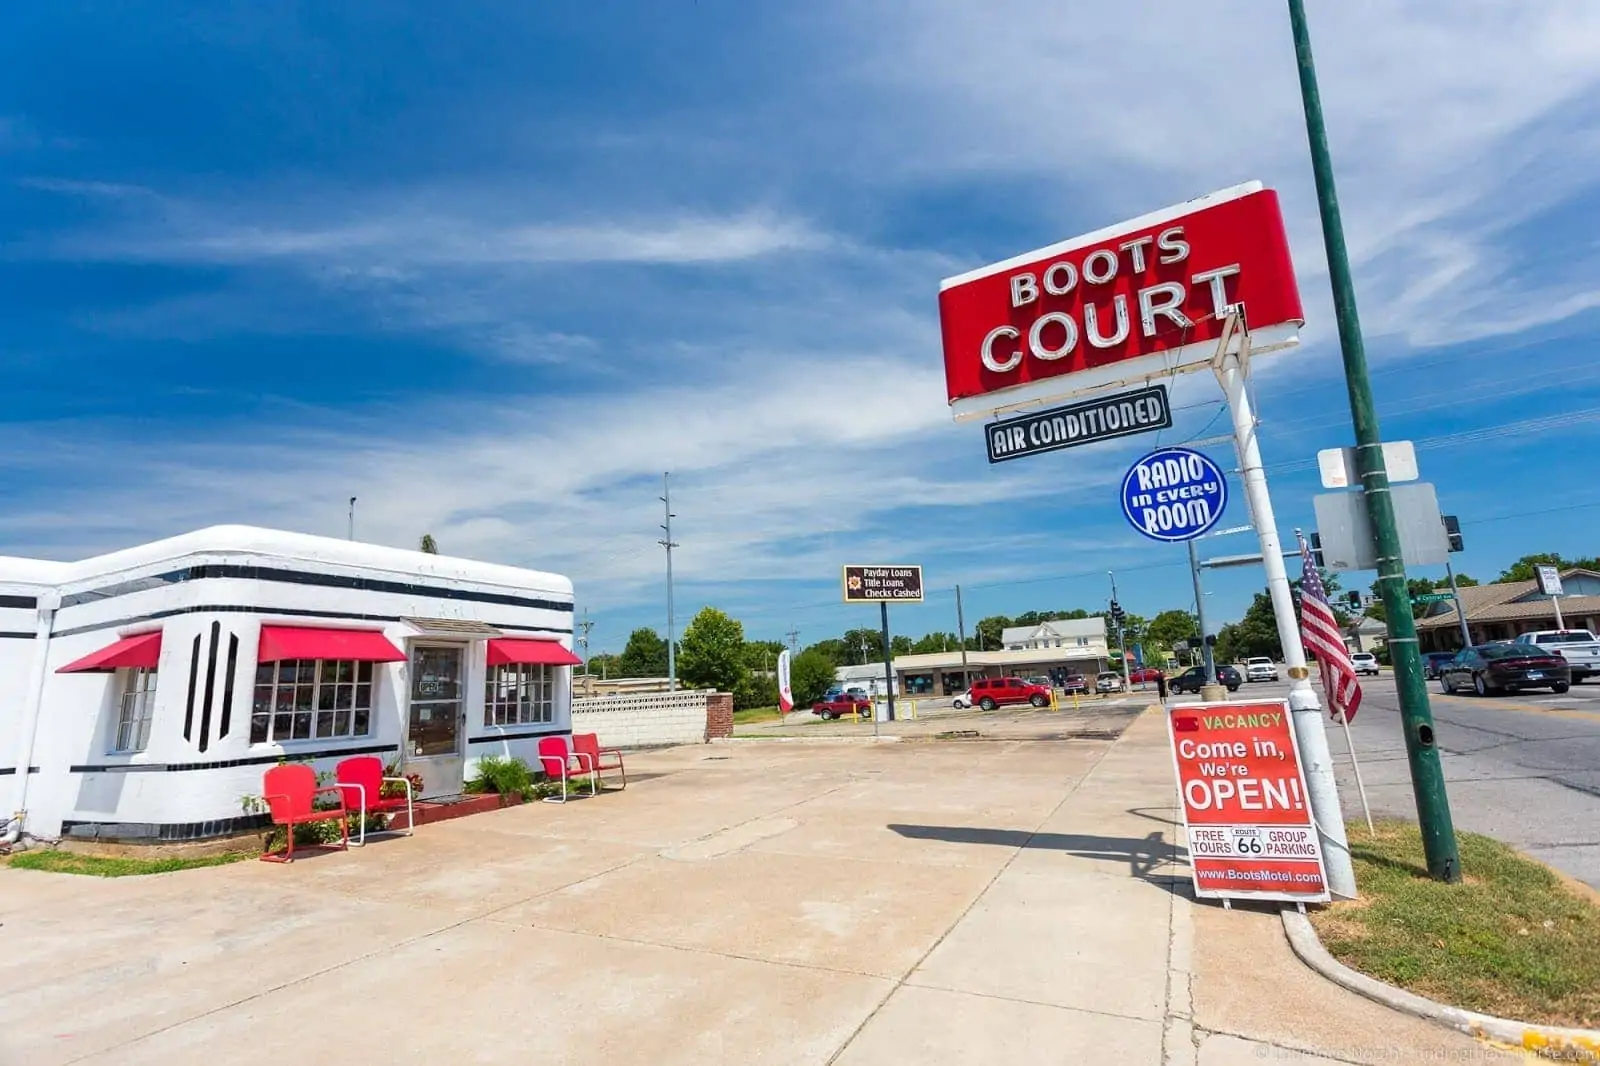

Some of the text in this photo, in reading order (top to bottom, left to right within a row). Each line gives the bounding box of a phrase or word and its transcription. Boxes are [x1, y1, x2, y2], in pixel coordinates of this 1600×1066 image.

[1010, 226, 1191, 308] BOOTS
[981, 263, 1240, 373] COURT
[993, 396, 1162, 454] AIR CONDITIONED
[1137, 454, 1204, 491] RADIO
[1156, 482, 1217, 503] EVERY
[1142, 499, 1212, 533] ROOM
[864, 568, 912, 578] Payday Loans
[864, 579, 904, 587] Title Loans
[865, 589, 920, 598] Checks Cashed
[1203, 713, 1281, 730] VACANCY
[1179, 736, 1285, 760] Come in,
[1199, 762, 1249, 777] We're
[1185, 778, 1305, 811] OPEN!
[1195, 831, 1225, 842] FREE
[1269, 831, 1308, 843] GROUP
[1193, 841, 1232, 854] TOURS
[1237, 838, 1262, 854] 66
[1266, 843, 1316, 856] PARKING
[1198, 868, 1321, 883] www.BootsMotel.com
